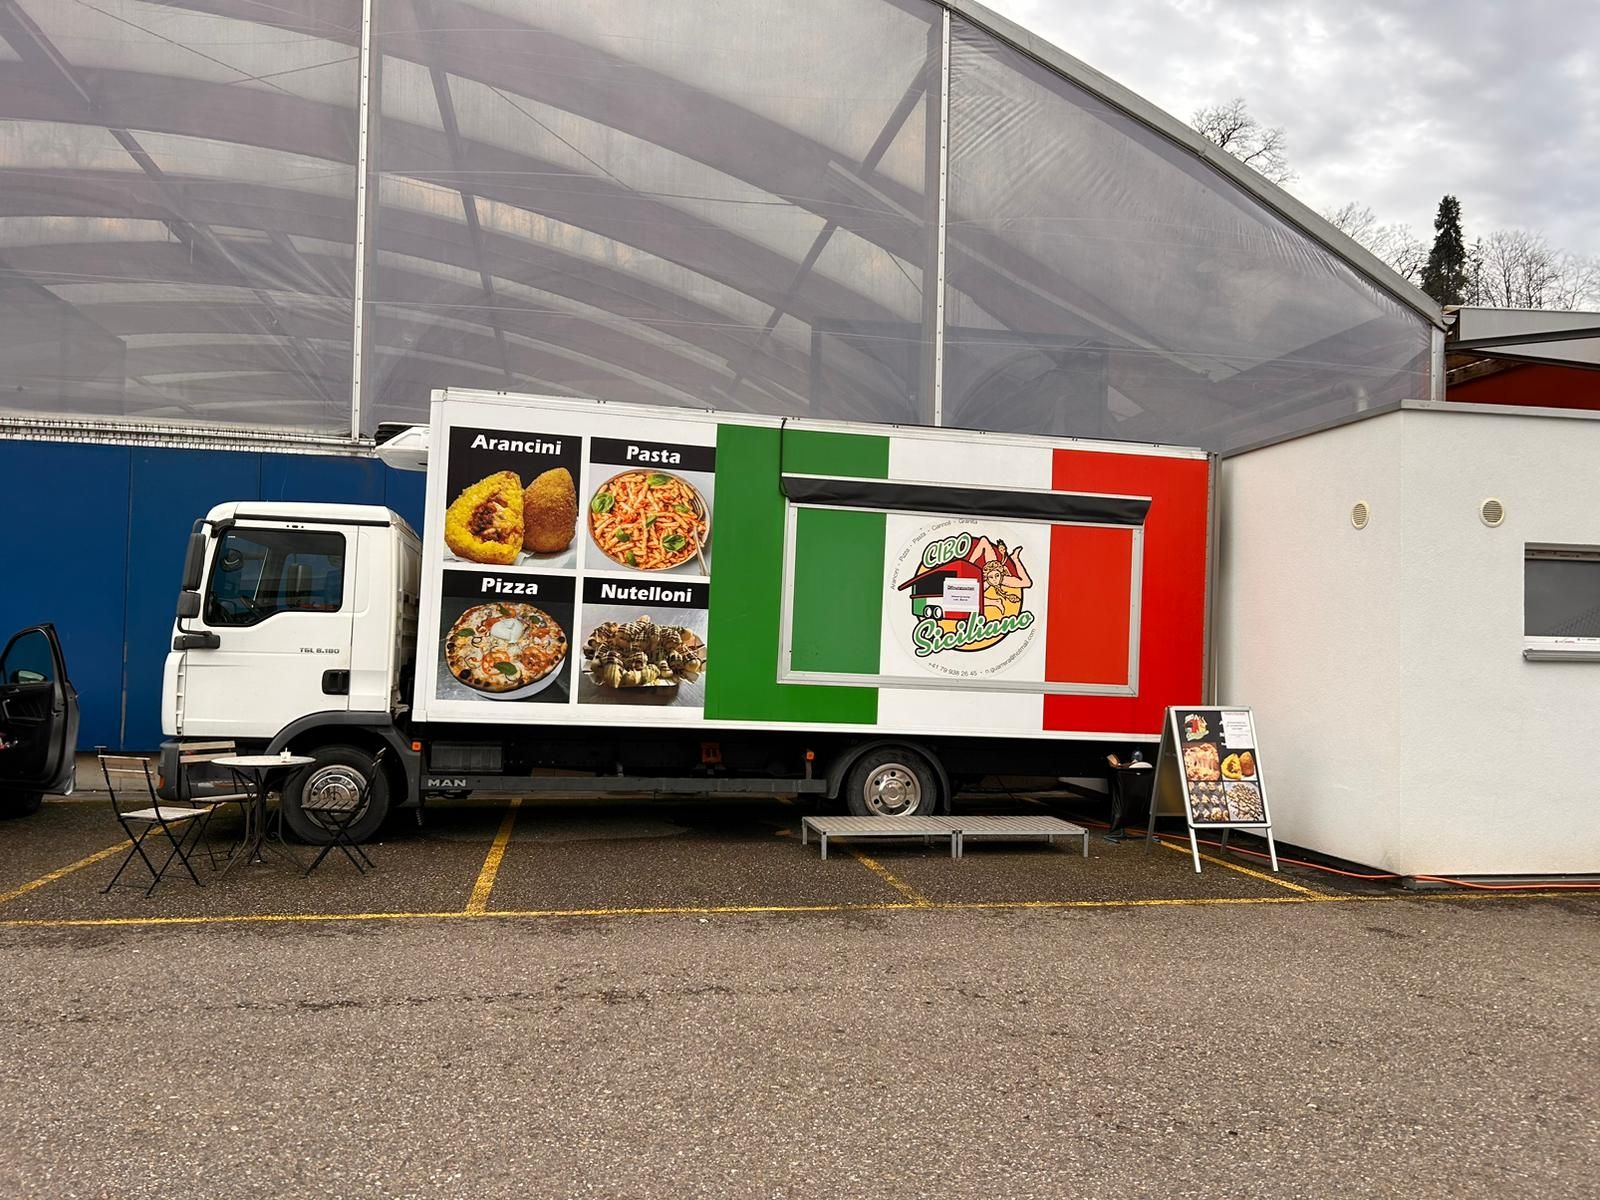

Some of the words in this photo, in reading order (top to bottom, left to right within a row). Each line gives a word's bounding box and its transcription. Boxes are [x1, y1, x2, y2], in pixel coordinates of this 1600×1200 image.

[470, 433, 562, 456] Arancini
[626, 445, 682, 465] Pasta
[912, 532, 926, 544] Pasta
[923, 533, 971, 568] CIBO
[481, 577, 538, 595] Pizza
[601, 583, 692, 603] Nutelloni
[914, 611, 1034, 656] Siciliano
[428, 779, 466, 787] MAN
